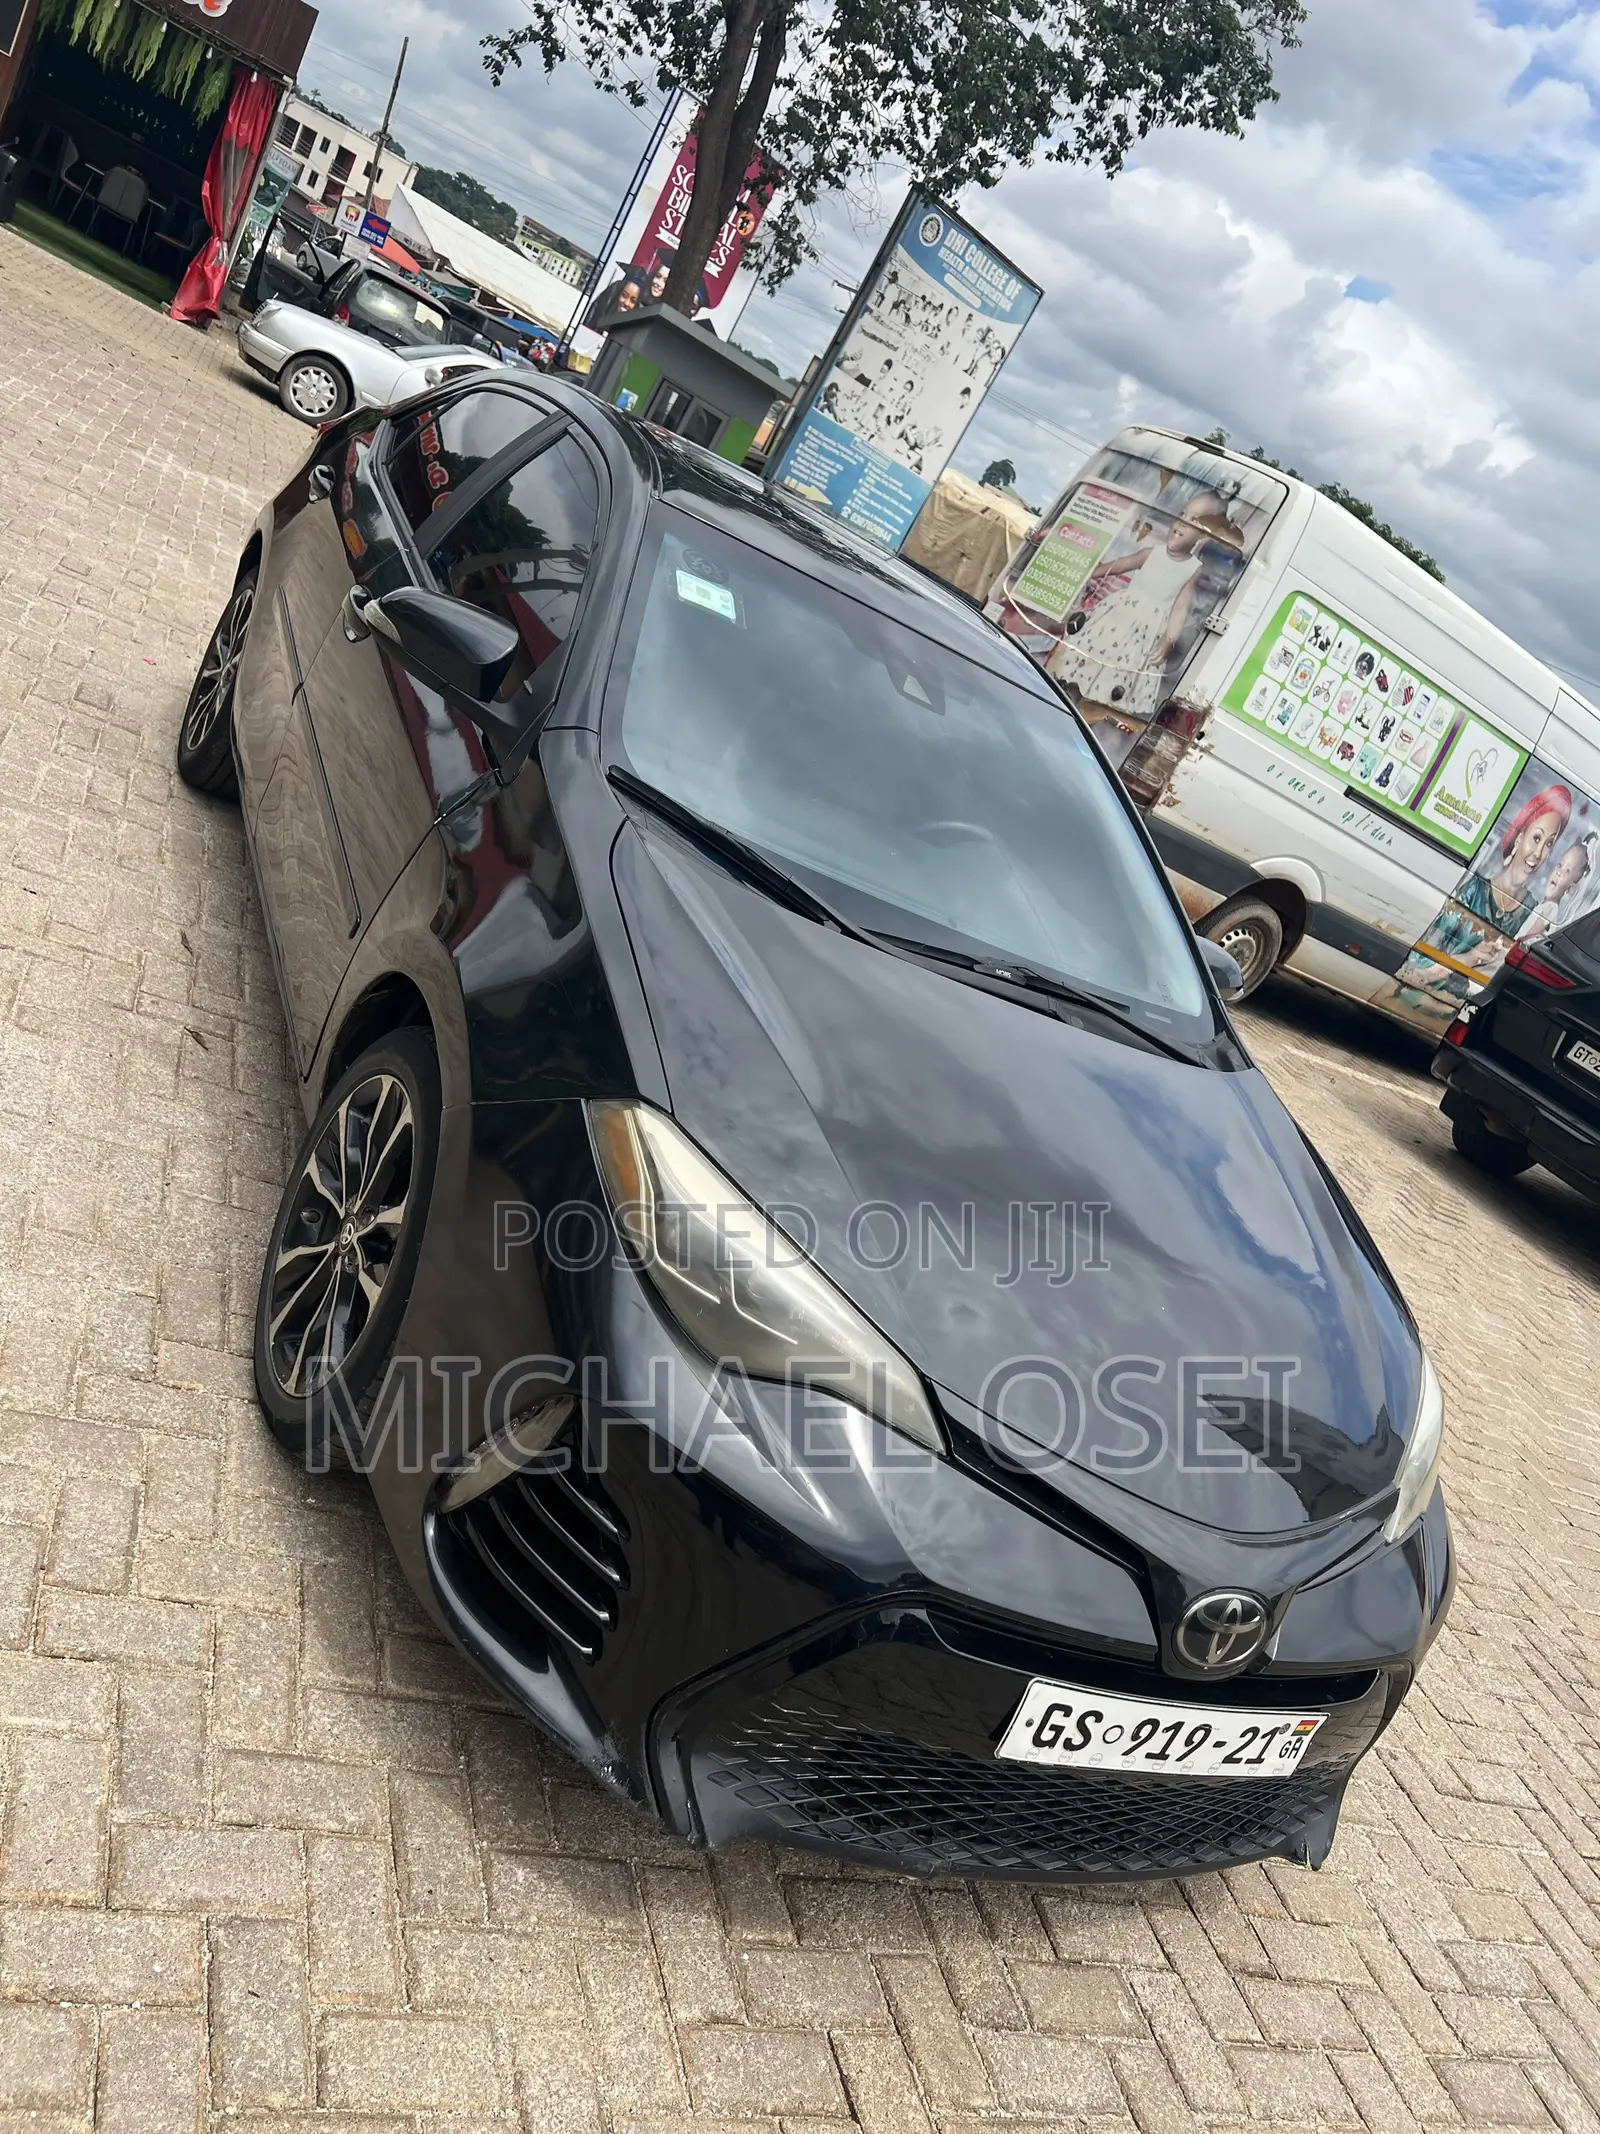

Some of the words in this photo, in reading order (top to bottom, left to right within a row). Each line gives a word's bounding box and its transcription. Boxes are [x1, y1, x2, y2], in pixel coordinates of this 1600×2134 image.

[938, 246, 966, 272] HEALTH
[962, 266, 979, 285] AND
[975, 278, 1013, 312] EDUCATION
[943, 228, 970, 255] DHI
[965, 244, 1009, 292] COLLEGE
[1004, 277, 1023, 300] OF
[1060, 527, 1095, 549] Contacts
[1573, 1046, 1593, 1063] GT
[1031, 1703, 1105, 1752] GS
[1121, 1717, 1283, 1764] 919-21
[1279, 1738, 1304, 1759] GH
